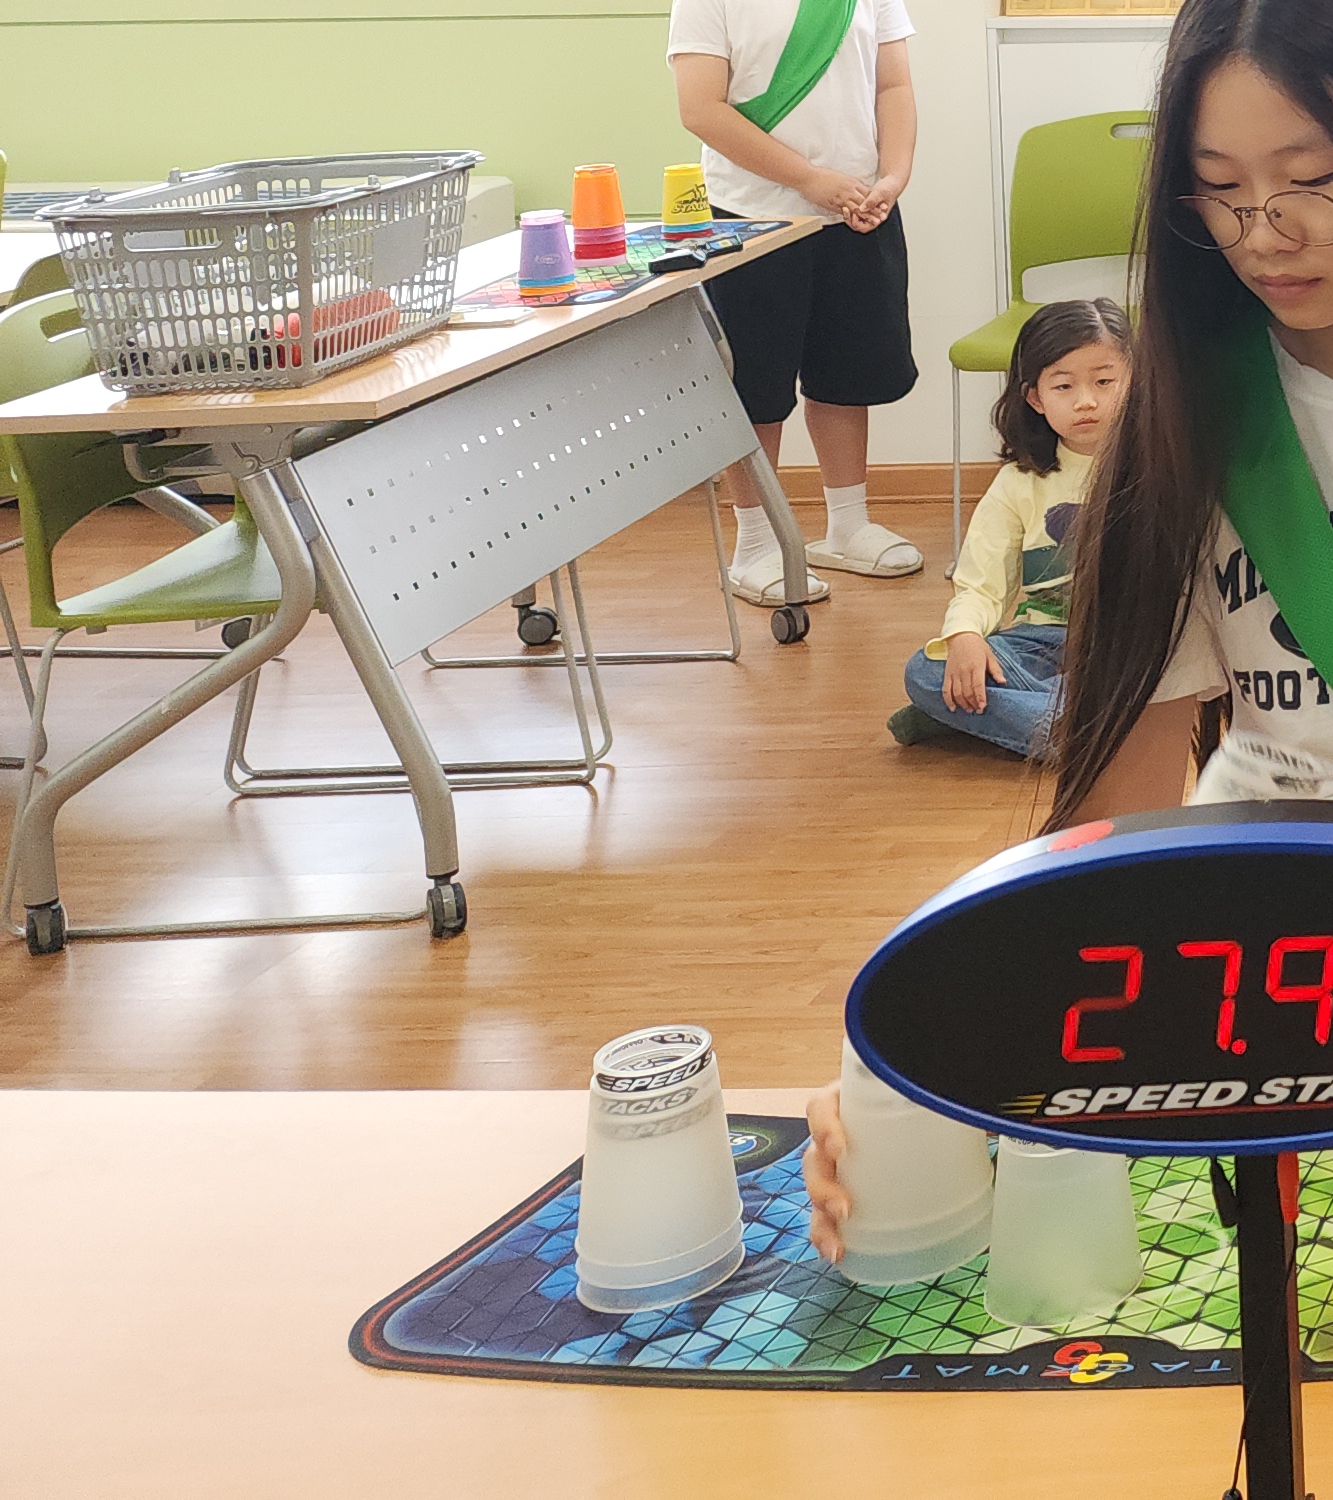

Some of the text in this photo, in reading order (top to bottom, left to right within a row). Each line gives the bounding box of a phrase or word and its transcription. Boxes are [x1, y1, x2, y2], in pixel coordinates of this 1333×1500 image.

[612, 1061, 699, 1093] SPEED
[1044, 1082, 1247, 1117] SPEED
[881, 1358, 1232, 1380] TACK MAT
